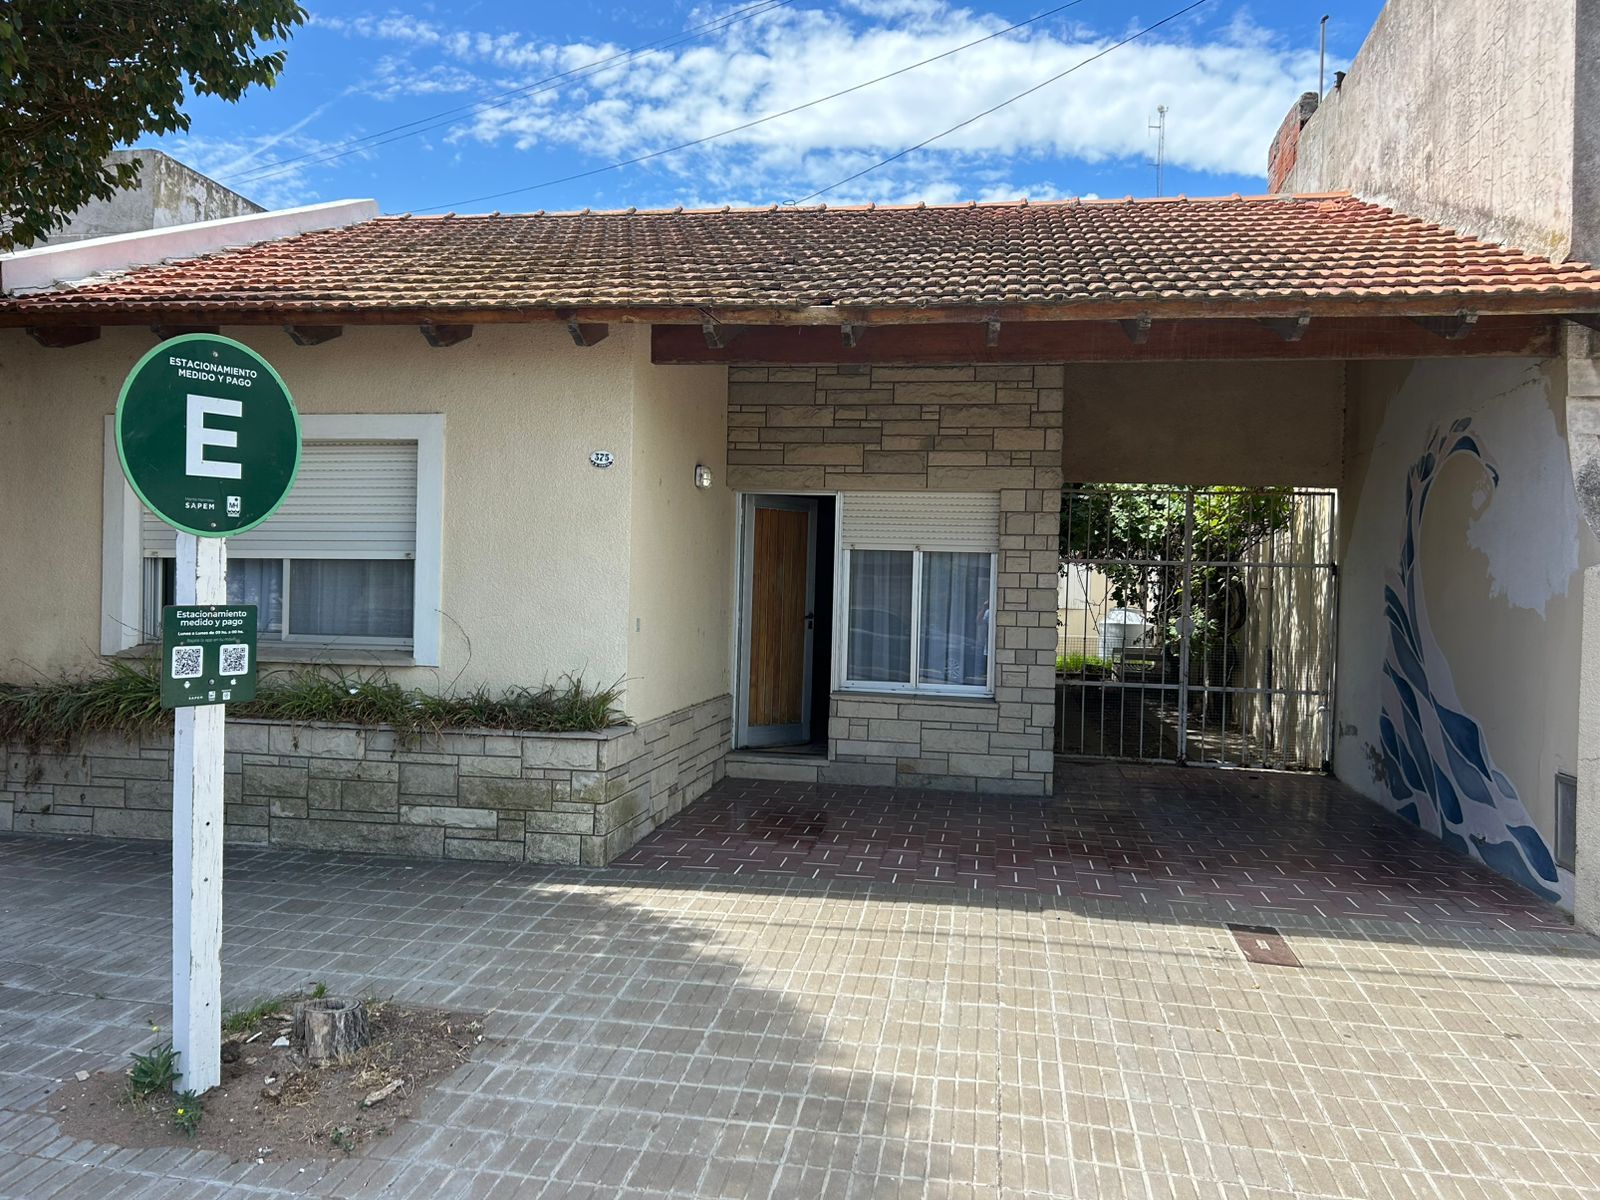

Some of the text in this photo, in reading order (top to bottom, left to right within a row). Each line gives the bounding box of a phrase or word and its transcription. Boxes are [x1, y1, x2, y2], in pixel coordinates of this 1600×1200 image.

[169, 356, 257, 378] ESTACIONAMIENTO
[178, 368, 252, 387] MEDIDO Y PAGO
[186, 393, 242, 479] E
[184, 501, 215, 510] SAPEM
[176, 609, 247, 619] Estacionamiento
[180, 618, 243, 627] medido y pago
